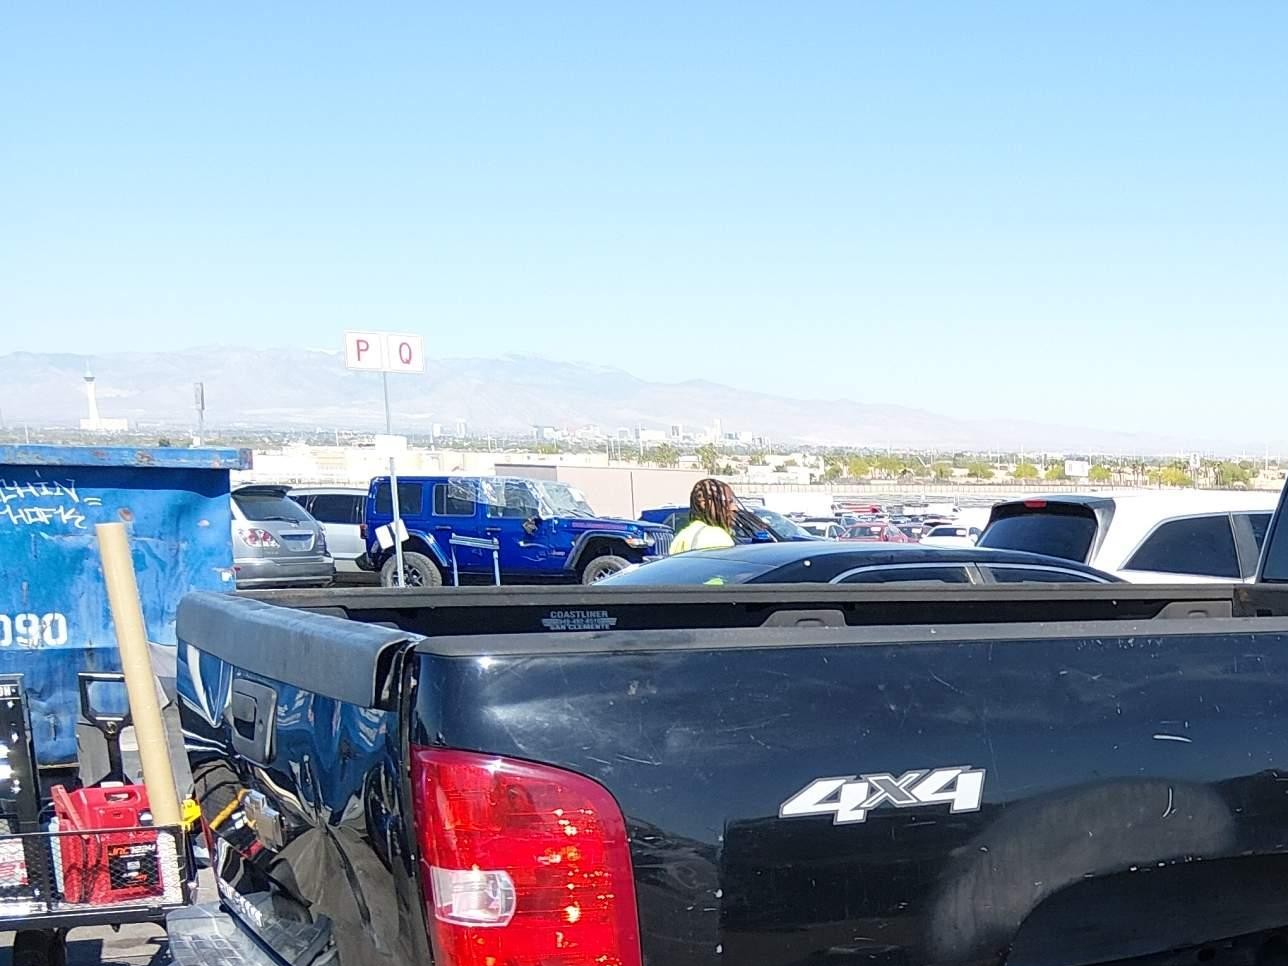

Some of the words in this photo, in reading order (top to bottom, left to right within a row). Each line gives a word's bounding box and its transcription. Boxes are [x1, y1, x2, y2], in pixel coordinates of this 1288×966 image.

[356, 339, 369, 361] P
[399, 341, 412, 365] Q
[550, 610, 609, 618] COASTLINER
